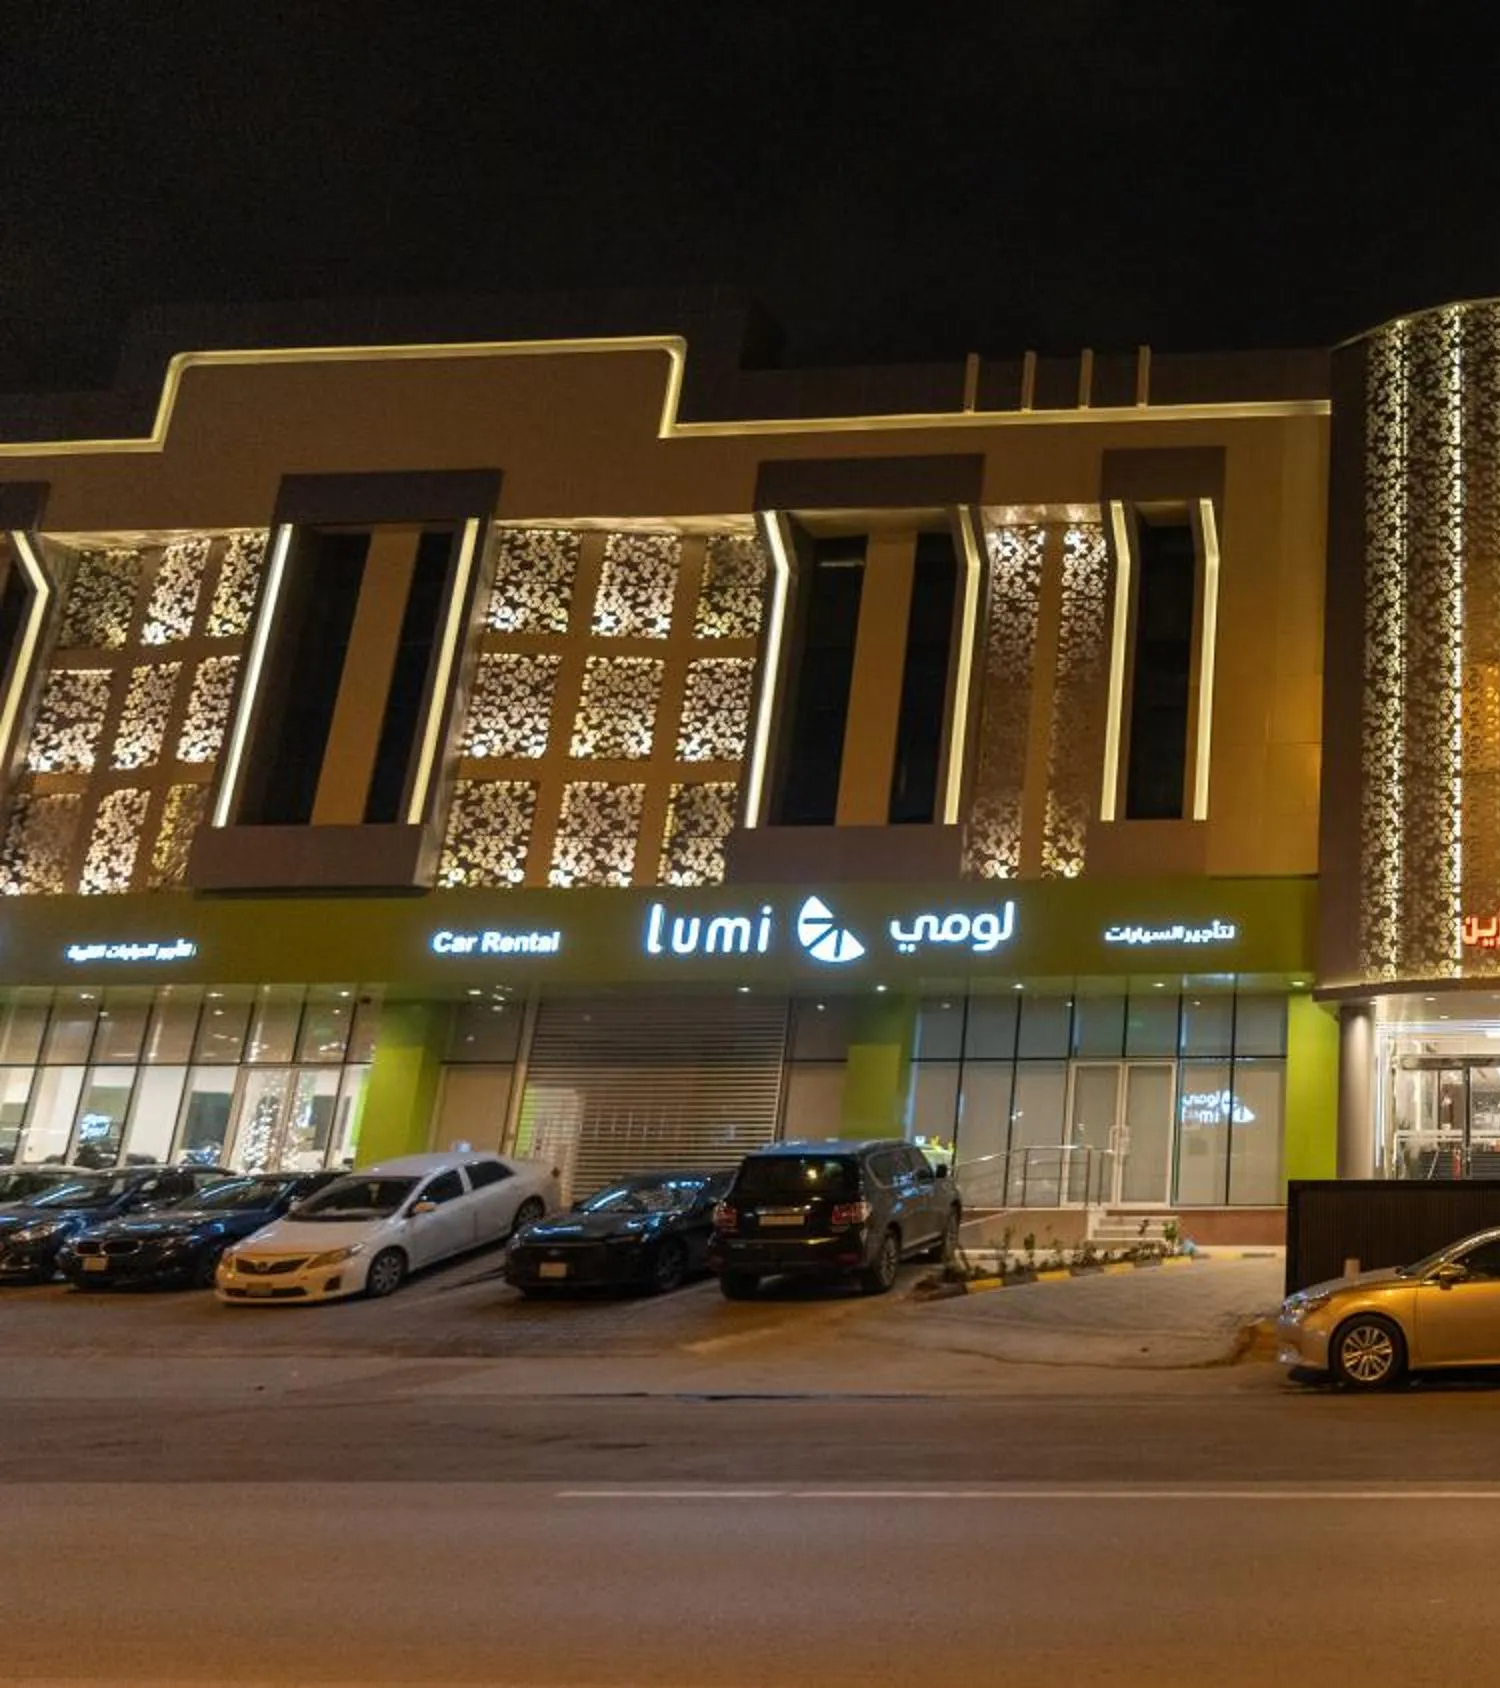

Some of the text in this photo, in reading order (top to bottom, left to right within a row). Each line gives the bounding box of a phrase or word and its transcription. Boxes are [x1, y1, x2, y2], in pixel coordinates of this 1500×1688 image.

[432, 930, 561, 953] Car Rental
[646, 902, 774, 954] lumi
[889, 900, 1016, 954] لومي
